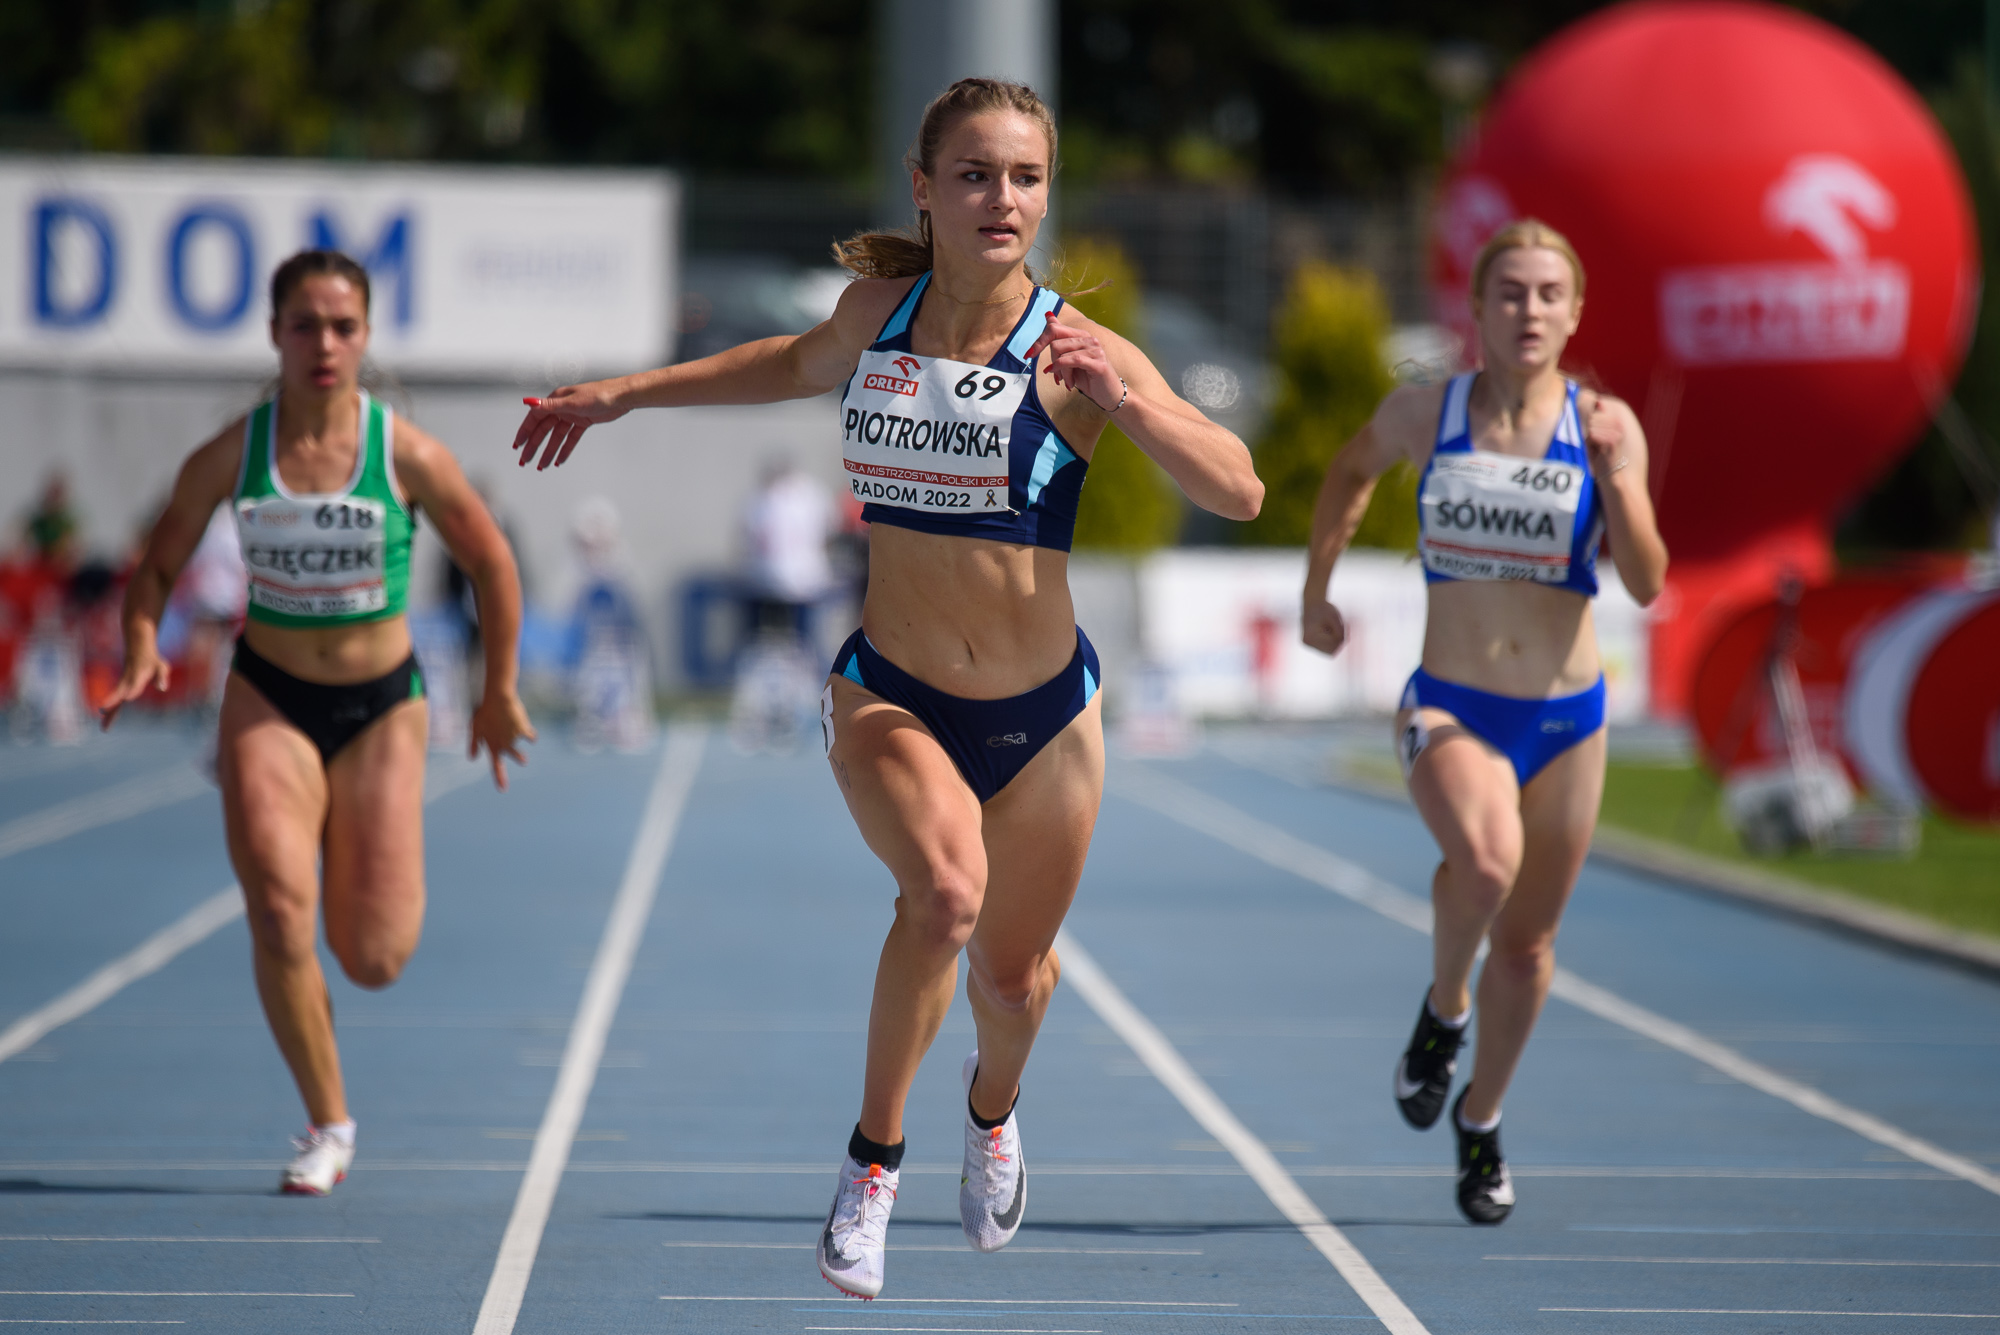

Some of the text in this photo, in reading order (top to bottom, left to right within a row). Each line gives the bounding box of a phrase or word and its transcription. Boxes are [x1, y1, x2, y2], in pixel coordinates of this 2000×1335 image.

[866, 375, 917, 395] ORLEN
[954, 370, 1006, 400] 69
[845, 408, 1003, 458] PIOTROWSKA
[846, 461, 1005, 486] PZLA MISTRZOSTWA POLSKI U20
[1511, 467, 1572, 493] 460
[852, 479, 971, 508] RADOM 2022
[314, 504, 374, 529] 618
[1436, 498, 1556, 540] SÓWKA
[248, 547, 377, 580] CZĘCZEK
